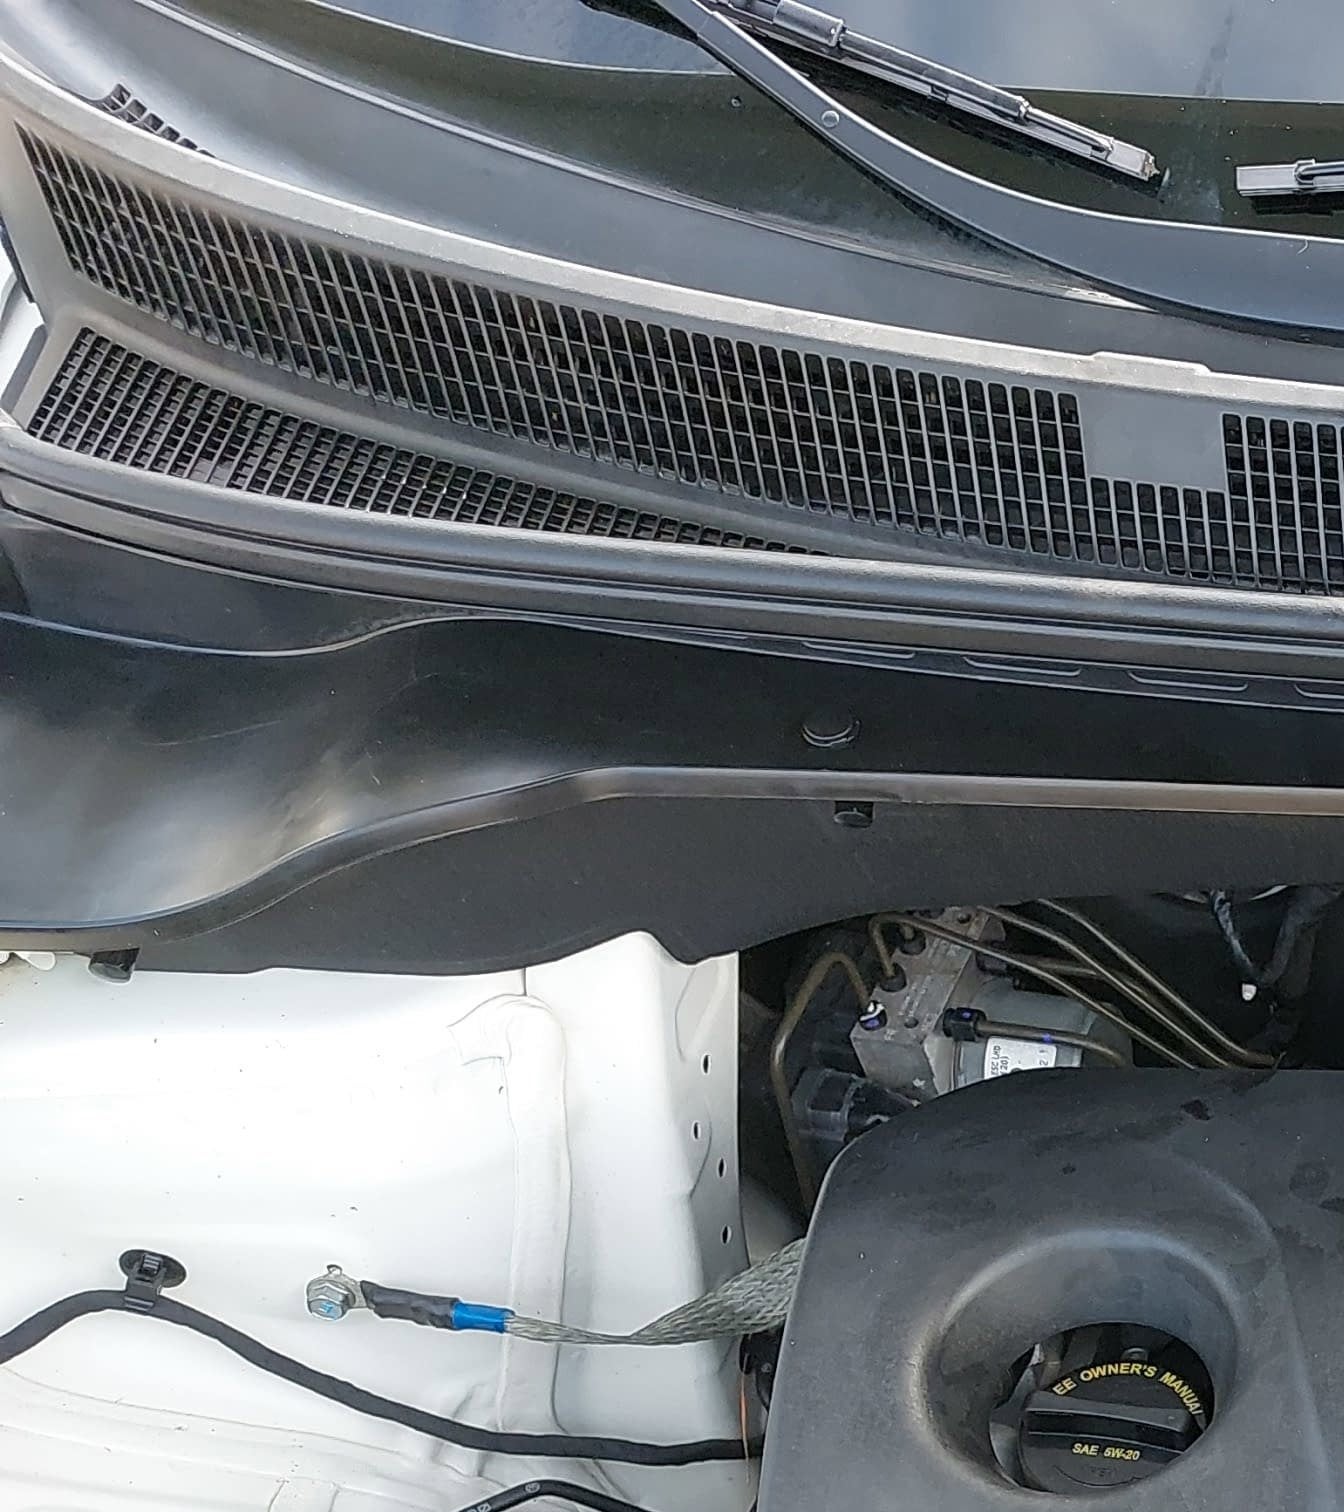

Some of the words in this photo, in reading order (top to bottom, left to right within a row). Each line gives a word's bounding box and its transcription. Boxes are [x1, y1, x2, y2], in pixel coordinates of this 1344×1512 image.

[1052, 1377, 1077, 1395] EE
[1080, 1363, 1157, 1381] OWNER'S
[1072, 1443, 1099, 1456] SAE
[1104, 1447, 1141, 1461] 5W-20
